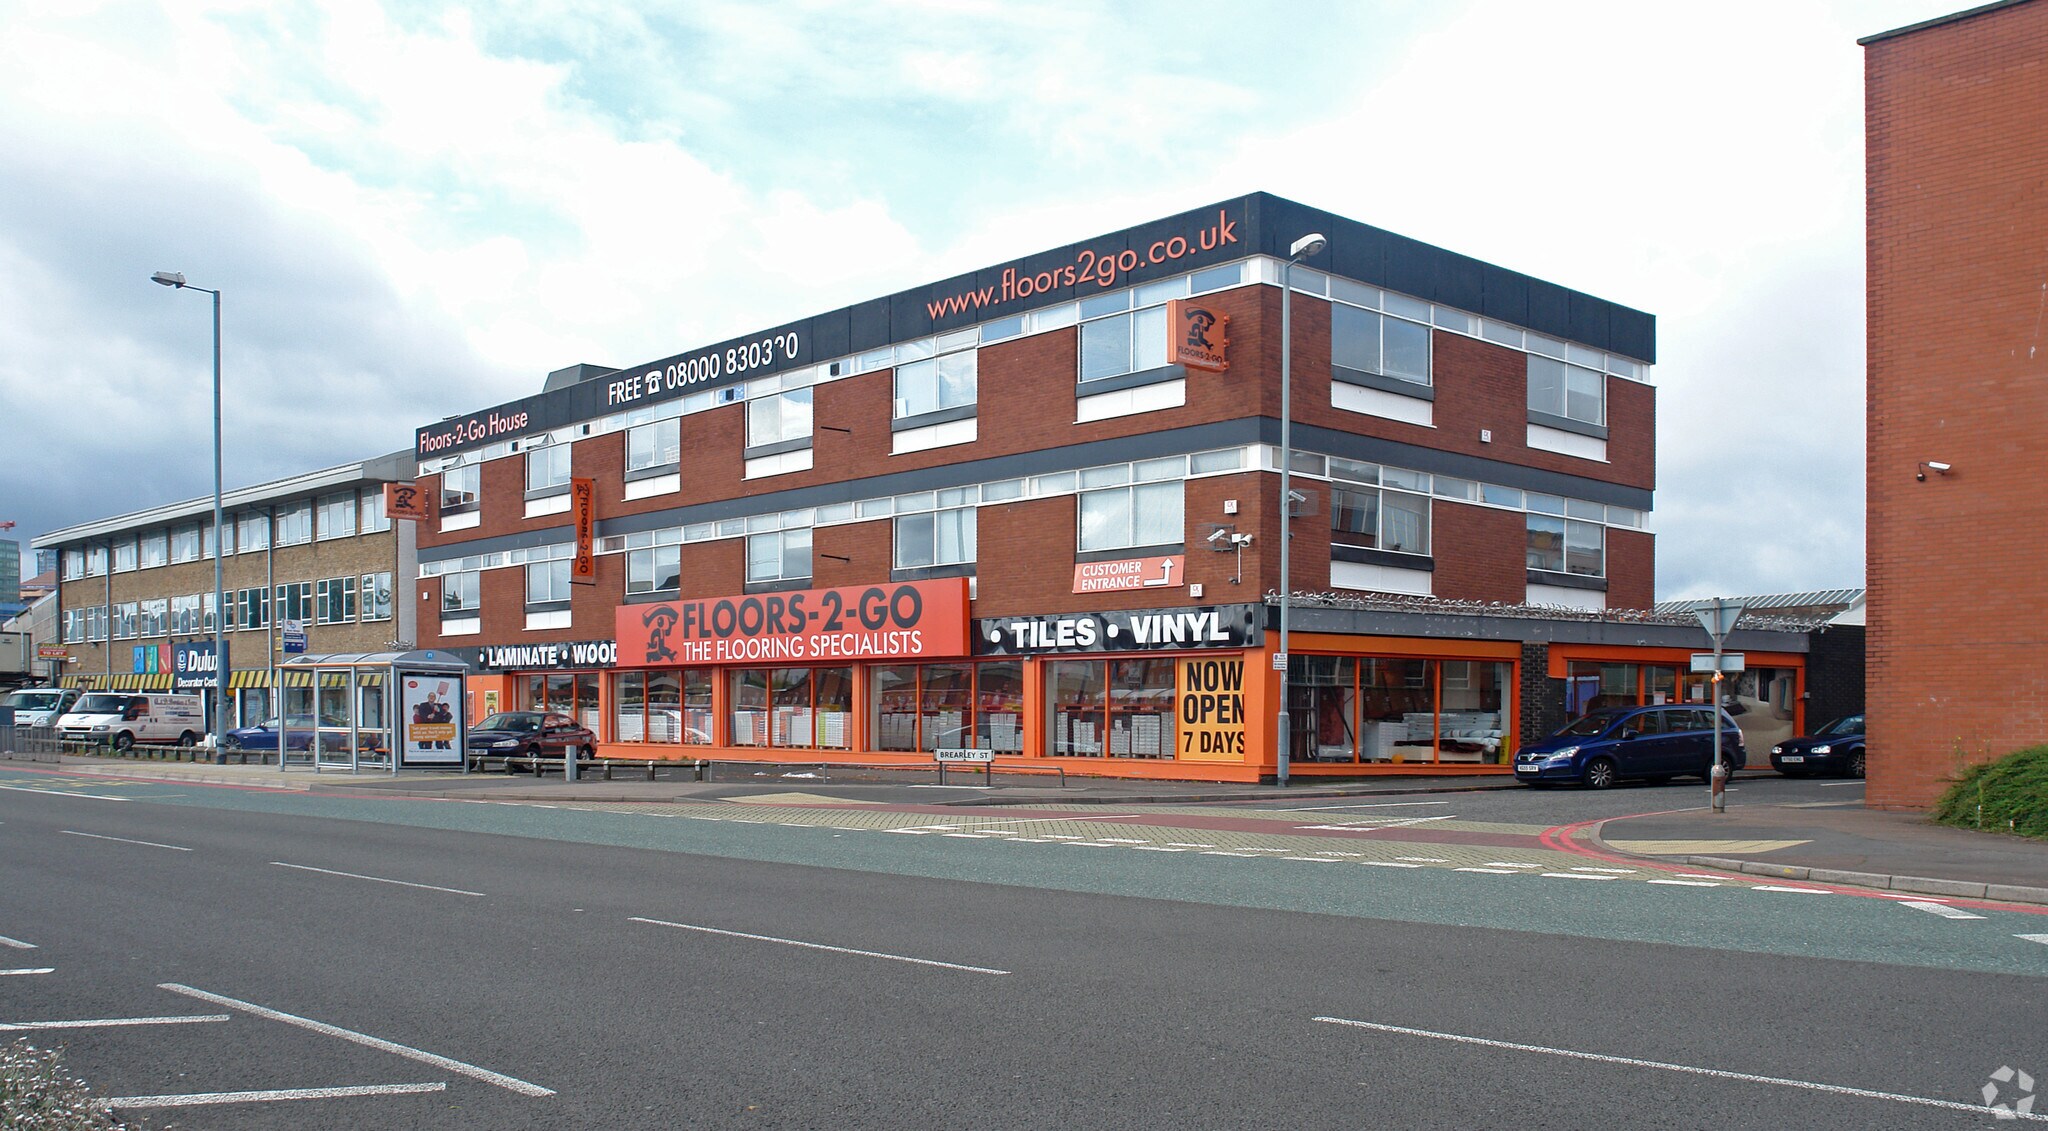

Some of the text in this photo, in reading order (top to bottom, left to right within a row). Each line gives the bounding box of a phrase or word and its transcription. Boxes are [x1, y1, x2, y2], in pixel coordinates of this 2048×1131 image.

[926, 209, 1238, 321] www.floors2go.co.uk
[608, 375, 642, 406] FREE
[665, 353, 721, 390] 08000
[419, 411, 528, 454] Floors-2-Go House
[579, 497, 589, 574] FLOORS-2-GO
[1081, 575, 1141, 591] ENTRANCE
[1082, 561, 1142, 577] CUSTOMER
[683, 586, 923, 640] FLOORS-2-GO
[1011, 611, 1230, 648] TILES VINYL
[488, 646, 558, 667] LAMINATE
[683, 630, 923, 662] THE FLOORING SPECIALISTS
[177, 677, 203, 688] Decorator
[1186, 660, 1244, 692] NOW
[1183, 694, 1244, 725] OPEN
[940, 751, 976, 759] BREARLEY
[1183, 731, 1244, 754] 7 DAYS
